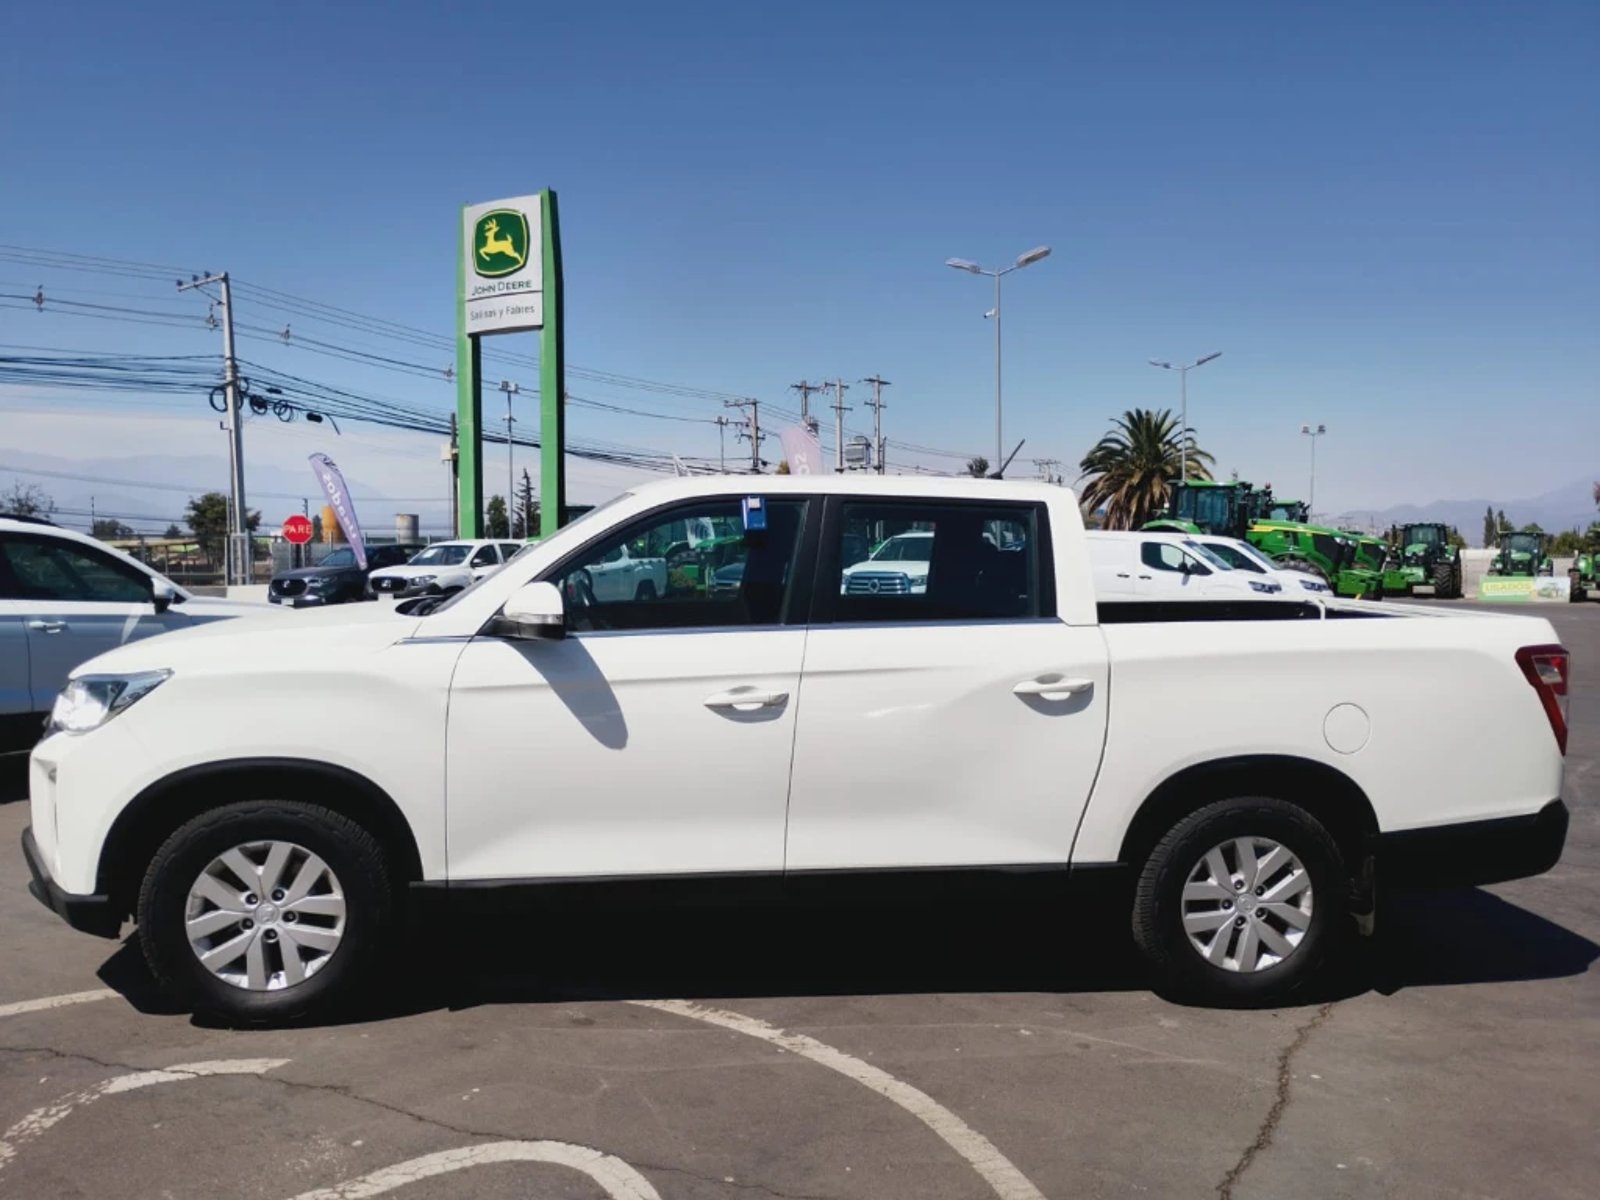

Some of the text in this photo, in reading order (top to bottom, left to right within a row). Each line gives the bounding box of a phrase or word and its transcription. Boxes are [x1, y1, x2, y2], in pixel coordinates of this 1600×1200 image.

[472, 279, 533, 296] JOHN DEERE
[283, 524, 312, 534] PARE
